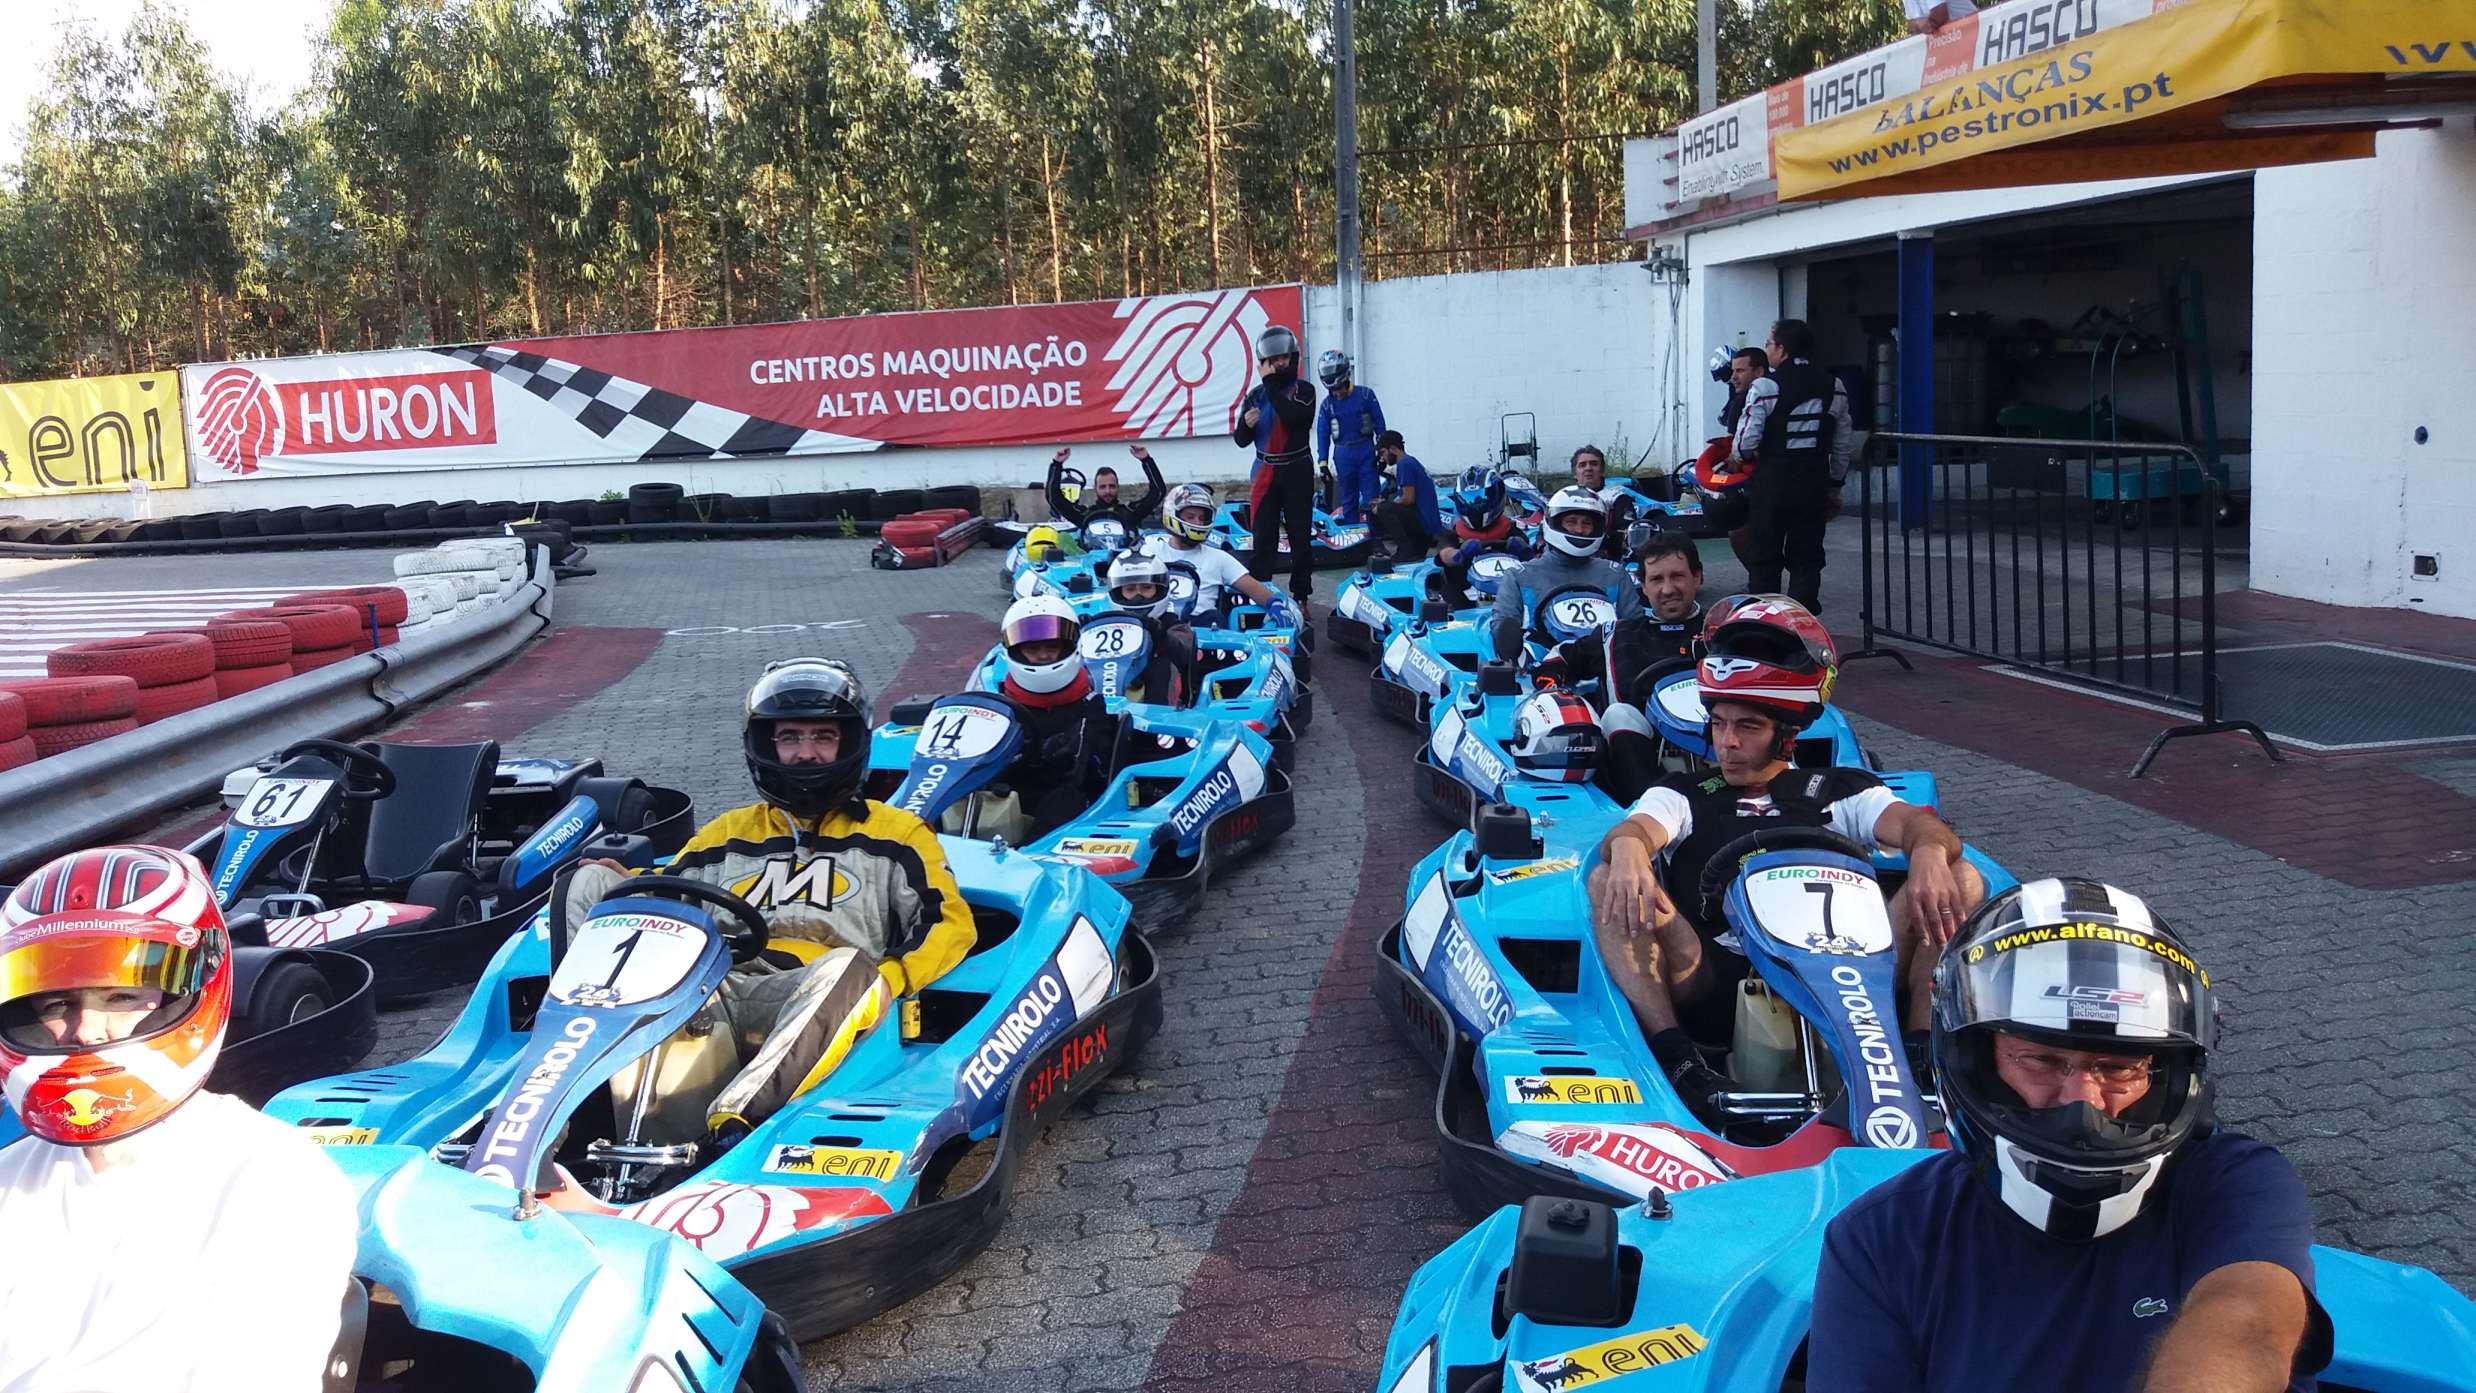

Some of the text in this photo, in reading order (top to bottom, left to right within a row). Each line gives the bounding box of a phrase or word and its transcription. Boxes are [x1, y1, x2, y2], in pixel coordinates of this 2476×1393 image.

[1983, 0, 2099, 67] HASCO
[1810, 62, 1886, 123] HASCO
[1682, 115, 1739, 167] HASCO
[1827, 71, 2176, 176] www.pestronix.pt
[750, 335, 1088, 386] CENTROS MAQUINAÇÃO
[300, 381, 478, 447] HURON
[816, 381, 1083, 420] ALTA VELOCIDADE
[29, 380, 166, 490] eni
[1567, 602, 1598, 624] 26
[1094, 629, 1124, 654] 28
[929, 714, 969, 750] 14
[251, 783, 309, 819] 61
[903, 763, 948, 814] NIROLO
[1173, 770, 1232, 836] TECNIROLO
[221, 830, 259, 890] TECNIROLO
[536, 816, 584, 859] TECNIROLO
[1766, 868, 1865, 885] EUROINDY
[590, 917, 688, 935] EUROINDY
[1803, 882, 1834, 940] 7
[612, 929, 644, 990] 1
[1993, 921, 2197, 975] www.alfano.com
[961, 974, 1062, 1101] TECNIROLO
[1831, 965, 1904, 1104] TECNIROLO
[484, 1016, 597, 1159] TECNIROLO
[1566, 1078, 1636, 1104] eni
[822, 1150, 895, 1178] eni
[1609, 1139, 1718, 1192] HURO
[1601, 1324, 1701, 1375] eni
